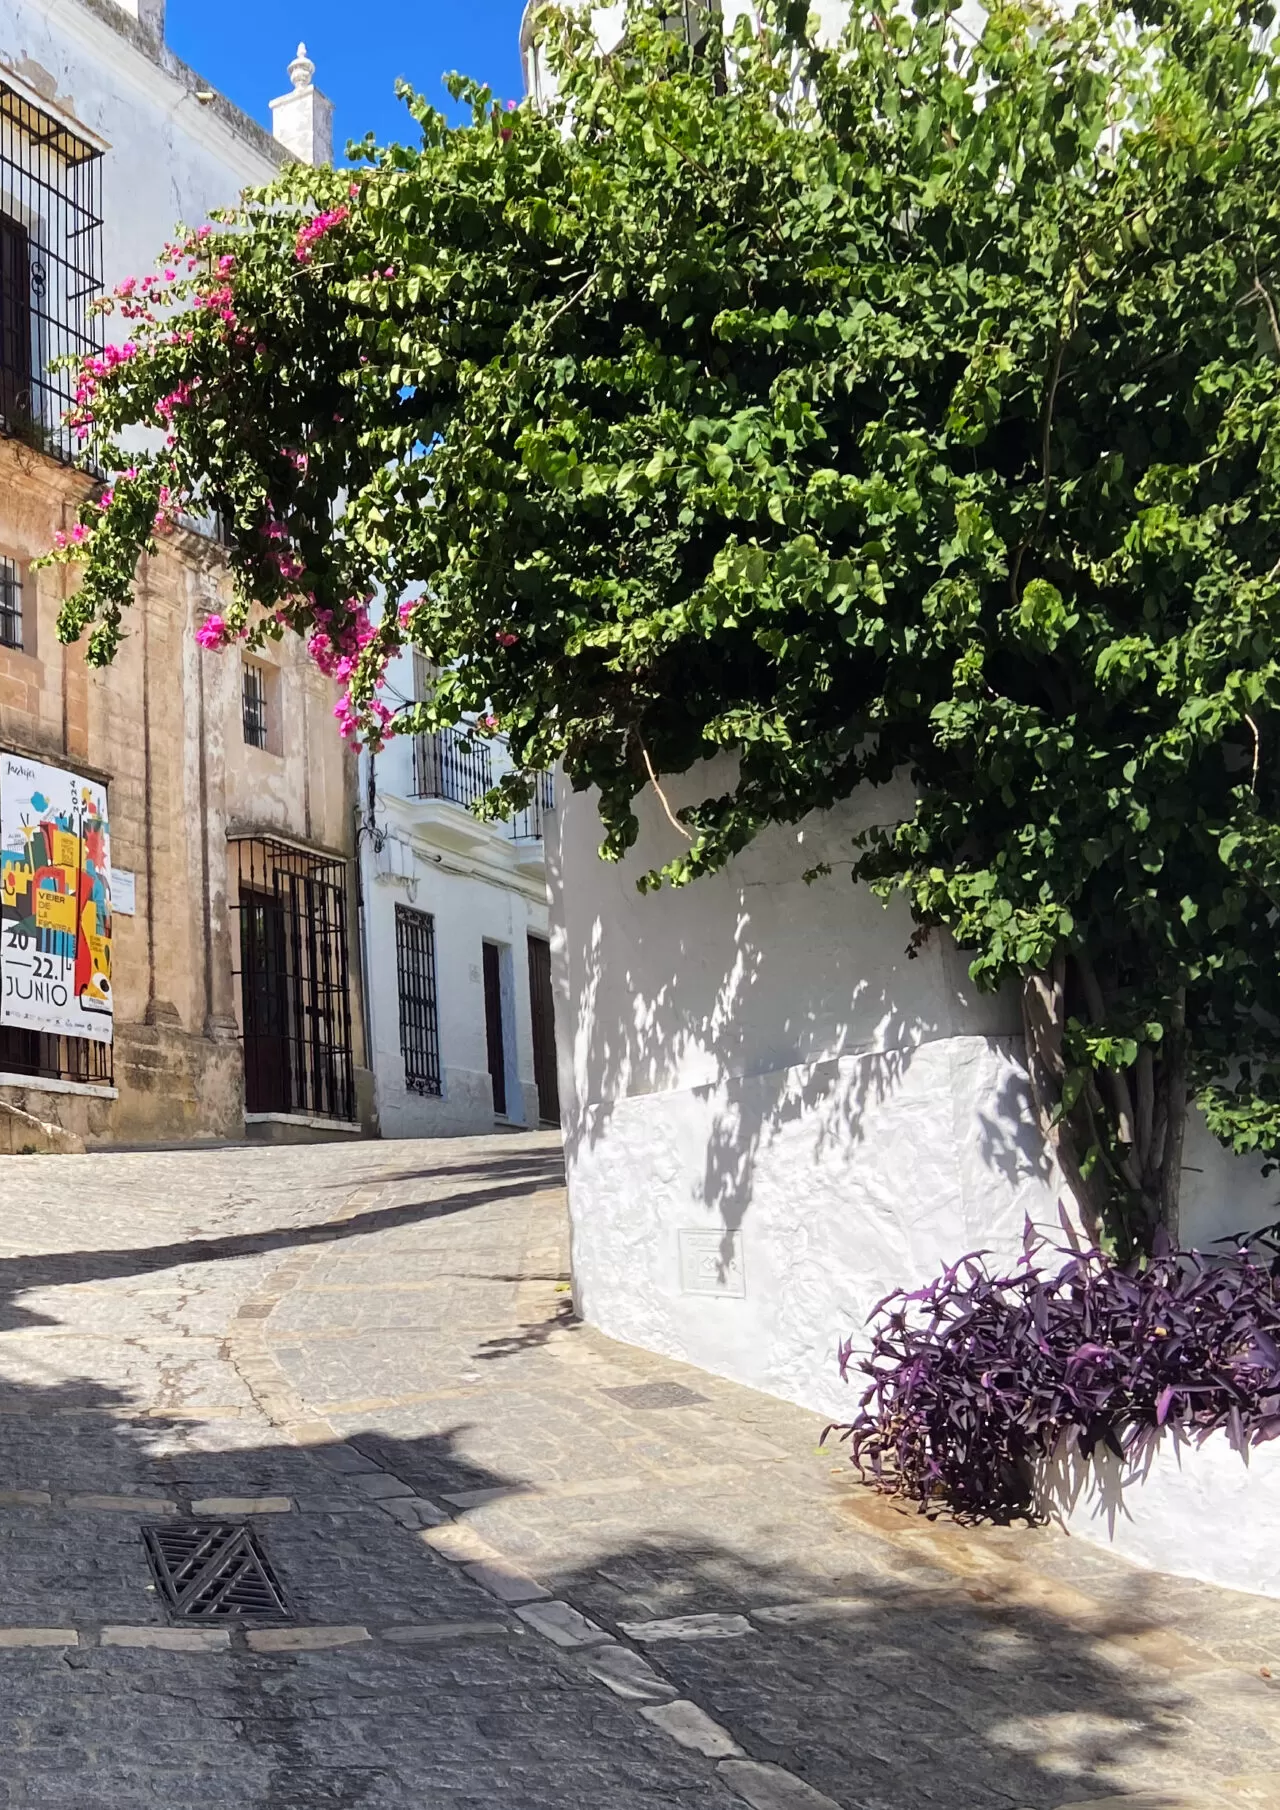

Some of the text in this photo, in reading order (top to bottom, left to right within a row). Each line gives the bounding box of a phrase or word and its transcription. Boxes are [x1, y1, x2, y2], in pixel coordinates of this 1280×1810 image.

[70, 780, 79, 813] 2024
[38, 901, 51, 910] DE
[39, 892, 65, 904] VEJER
[38, 910, 47, 918] LA
[7, 932, 28, 950] 20
[6, 976, 67, 1006] JUNIO
